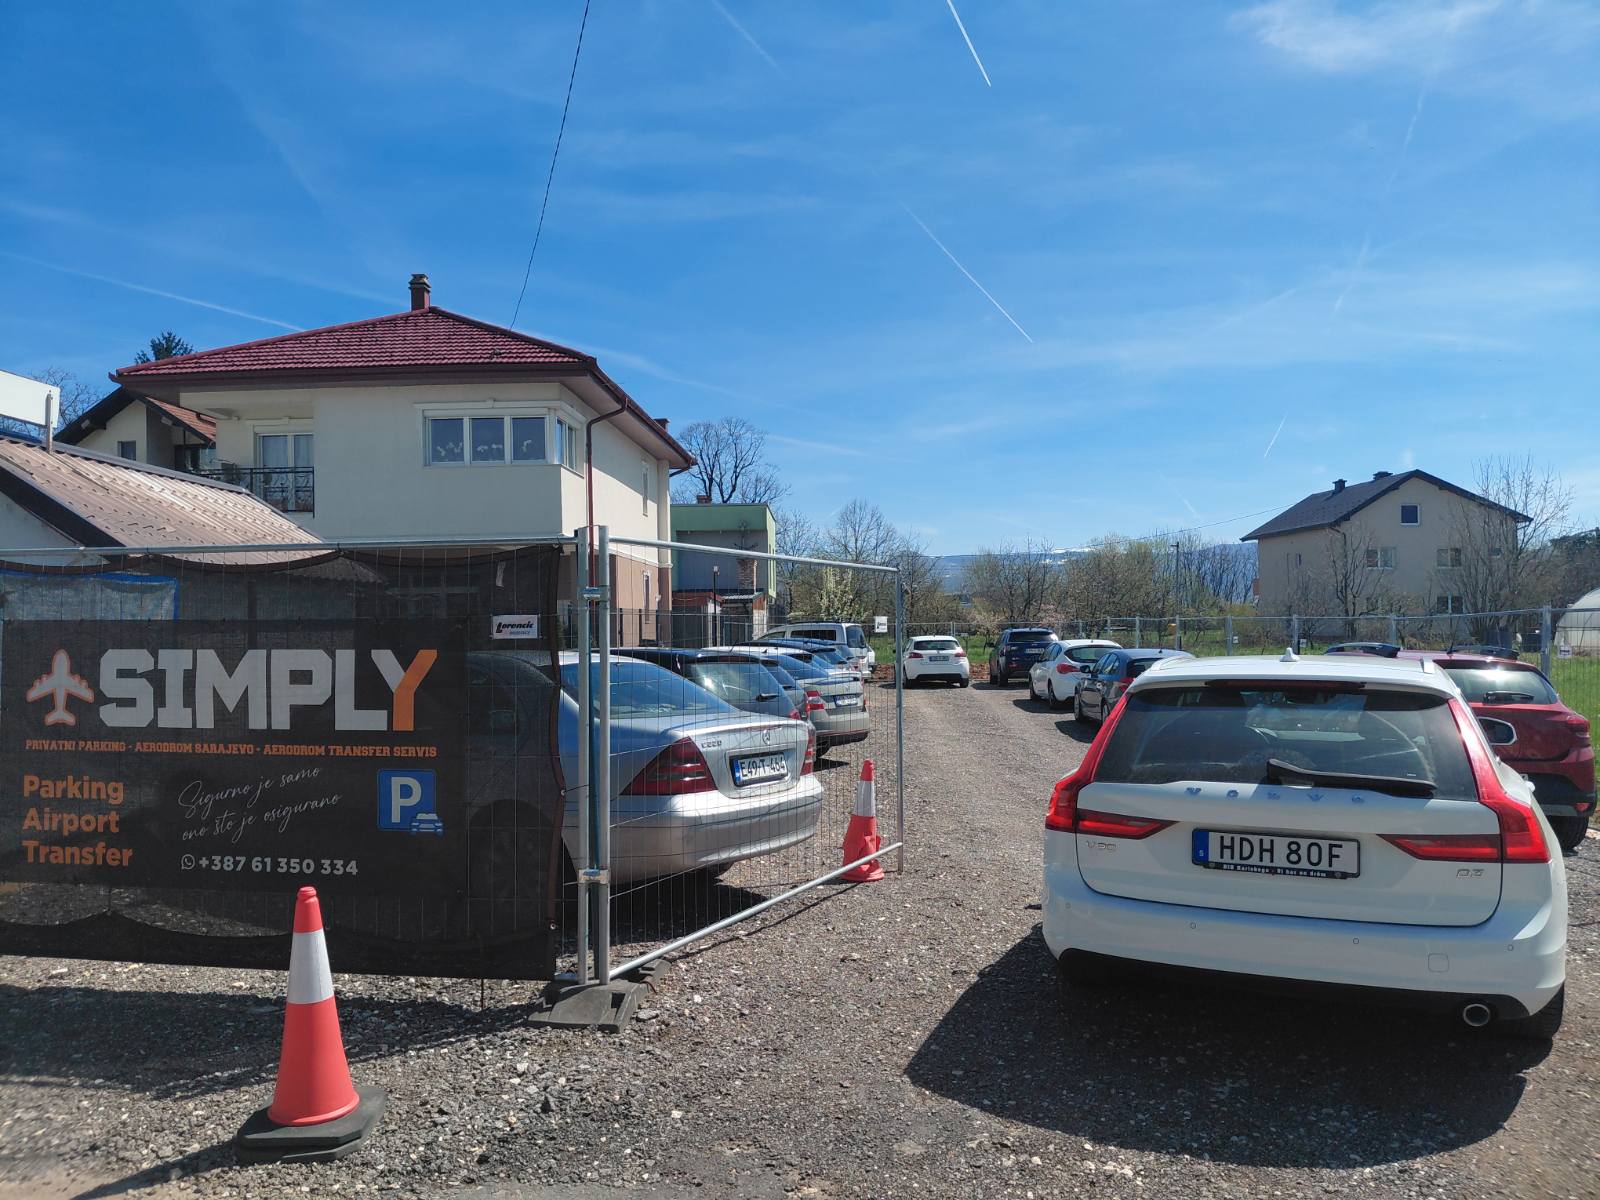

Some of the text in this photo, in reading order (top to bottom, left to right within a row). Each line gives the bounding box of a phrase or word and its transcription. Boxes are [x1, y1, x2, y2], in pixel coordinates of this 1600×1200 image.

[100, 648, 438, 731] SIMPLY
[25, 740, 76, 751] PRIVATNI
[78, 741, 126, 752] PARKING
[135, 742, 193, 754] AERODROM
[195, 743, 254, 755] SARAJEVO
[263, 744, 325, 756] AERODROM
[328, 746, 391, 757] TRANSFER
[393, 747, 437, 758] SERVIS
[23, 775, 124, 805] Parking
[178, 767, 320, 820] Sigurno je samo
[391, 776, 422, 824] P
[22, 807, 120, 836] Airport
[182, 827, 209, 841] ono
[231, 812, 256, 843] je
[263, 793, 342, 833] osigurano
[22, 840, 133, 867] Transfer
[199, 856, 358, 876] +387 61 350 334
[1219, 835, 1343, 868] HDH 80F
